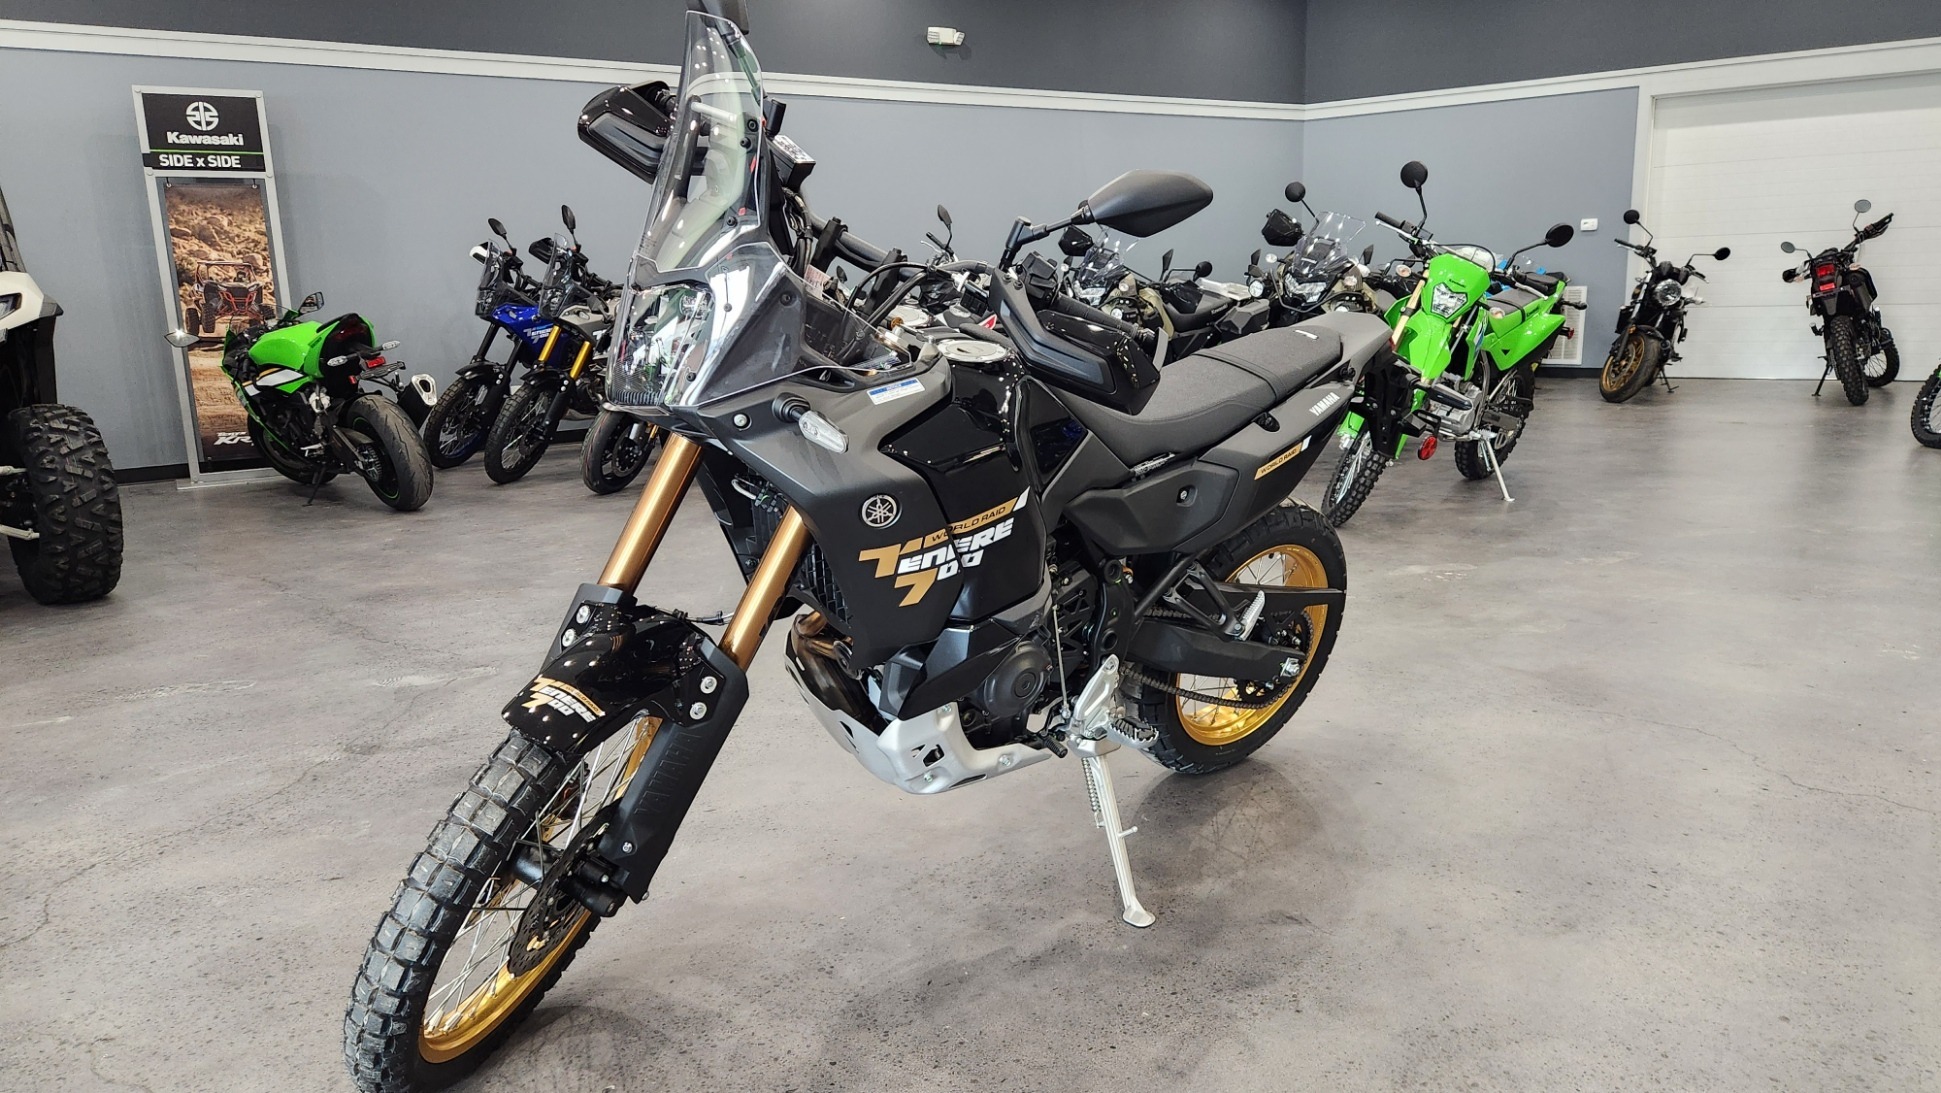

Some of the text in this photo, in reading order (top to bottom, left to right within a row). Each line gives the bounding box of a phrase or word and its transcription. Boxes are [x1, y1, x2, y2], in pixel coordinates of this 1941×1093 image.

[166, 131, 244, 146] Kawasaki
[159, 154, 194, 167] SIDE
[207, 155, 242, 168] SIDE
[1309, 392, 1340, 416] YAMAHA
[213, 435, 252, 445] KR
[931, 506, 1006, 542] WORLD RAID
[894, 549, 984, 608] 700
[521, 691, 576, 716] 700
